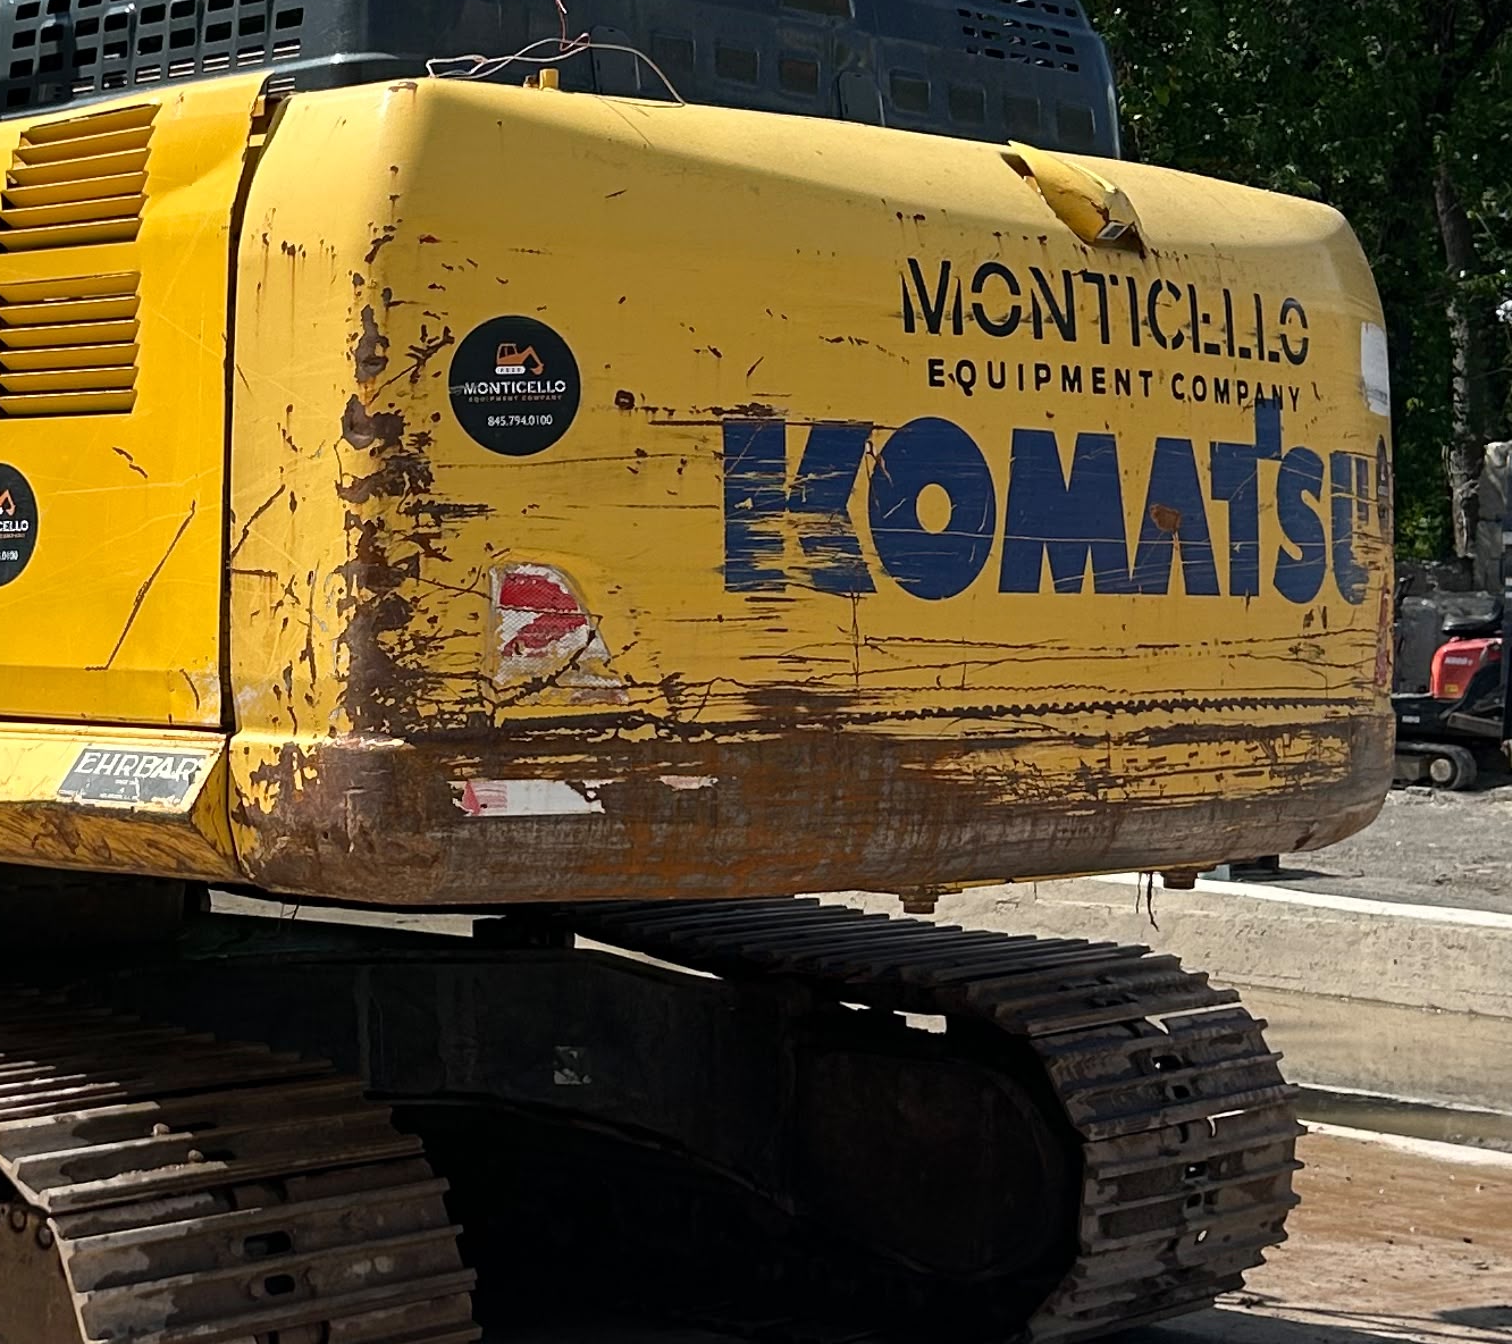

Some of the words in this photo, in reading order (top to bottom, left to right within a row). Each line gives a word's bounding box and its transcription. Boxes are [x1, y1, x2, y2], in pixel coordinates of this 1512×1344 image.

[900, 258, 1309, 366] MONTICELLO
[464, 380, 566, 395] MONTICELLO
[928, 358, 1153, 397] EQUIPMENT
[1171, 373, 1300, 412] COMPANY
[487, 414, 553, 427] 845.794.0100
[722, 399, 1370, 605] KOMATSU
